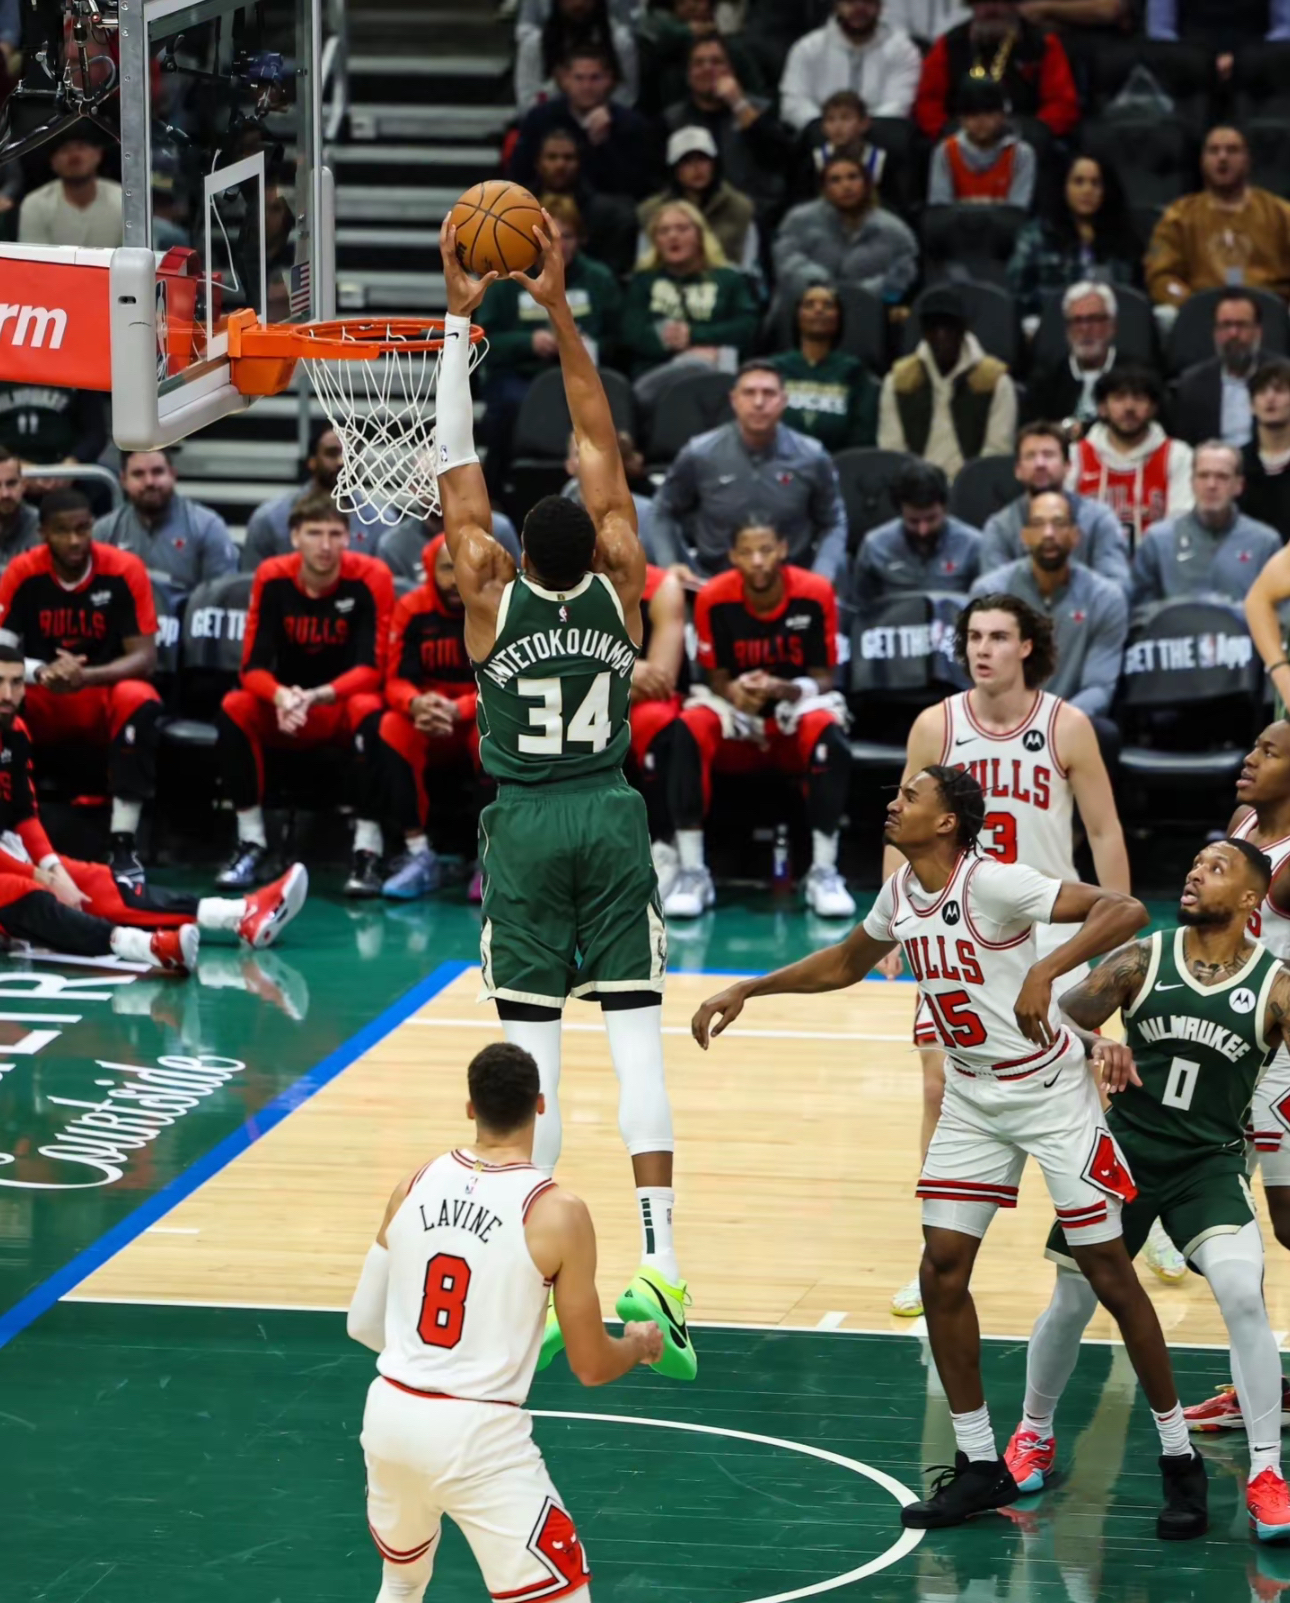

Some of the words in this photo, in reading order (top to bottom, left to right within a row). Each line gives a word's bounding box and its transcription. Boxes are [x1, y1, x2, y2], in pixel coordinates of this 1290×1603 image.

[191, 606, 225, 639] GET
[861, 626, 895, 659] GET
[1157, 636, 1196, 670] THE
[517, 671, 612, 755] 34
[983, 811, 1018, 864] 3
[924, 989, 988, 1049] 15
[1137, 1014, 1252, 1064] MILWAUKEE
[1161, 1056, 1201, 1111] 0
[419, 1198, 503, 1244] LAVINE
[416, 1251, 472, 1350] 8
